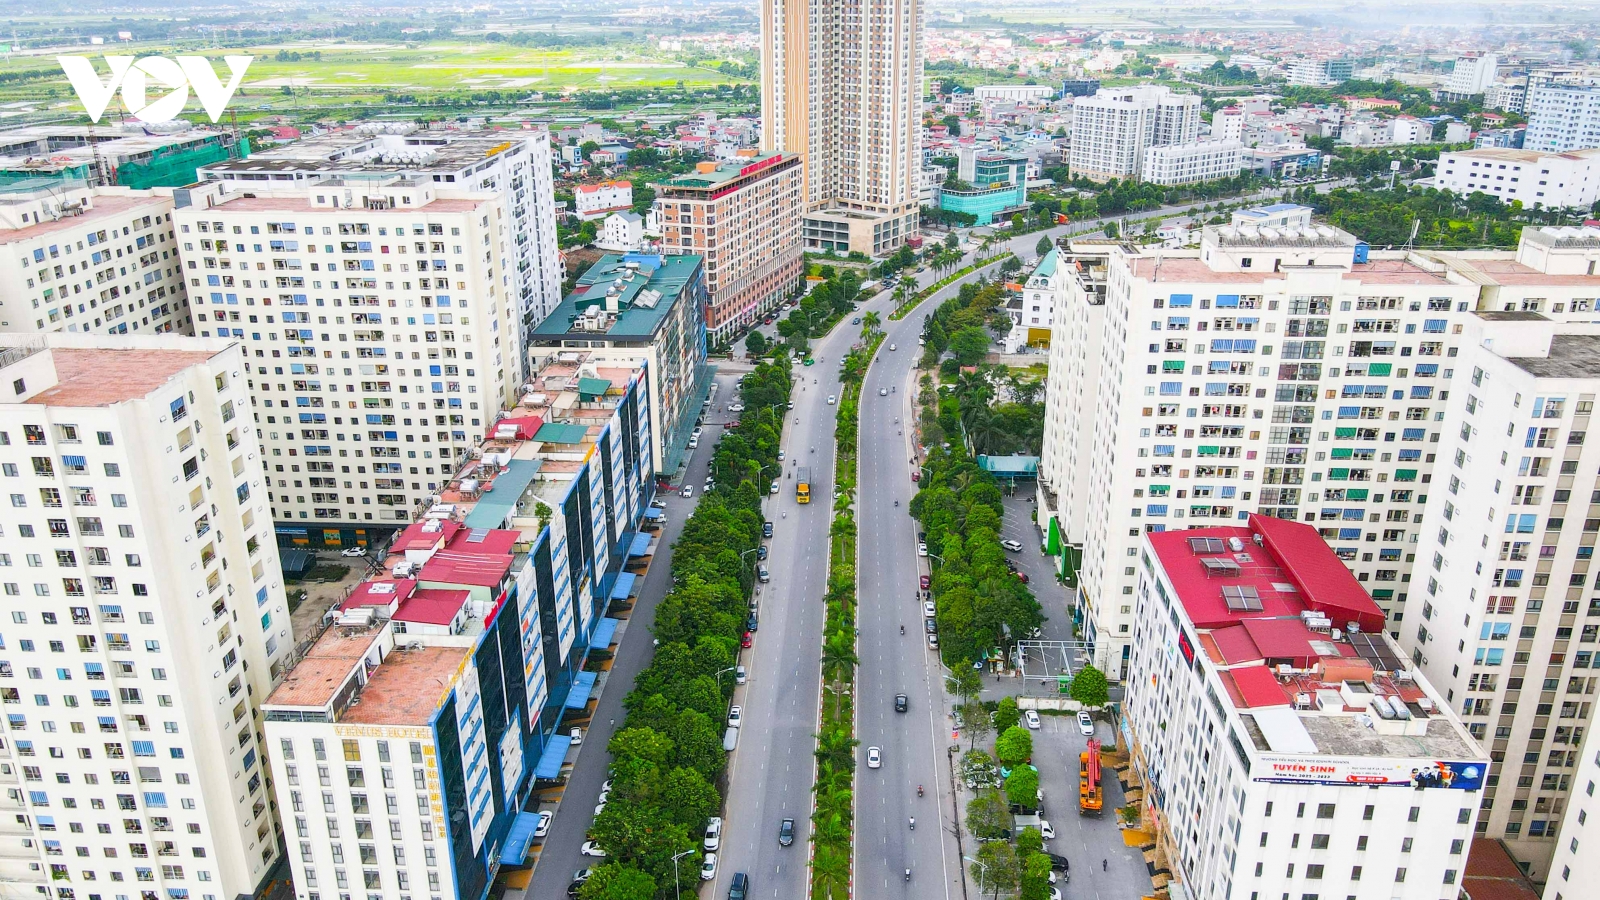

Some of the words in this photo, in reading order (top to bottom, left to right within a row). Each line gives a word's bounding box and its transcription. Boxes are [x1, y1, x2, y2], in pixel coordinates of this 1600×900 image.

[333, 725, 382, 738] VENUS
[387, 727, 432, 739] HOTEL
[1273, 763, 1307, 772] TUYỂN
[1309, 765, 1336, 773] SINH
